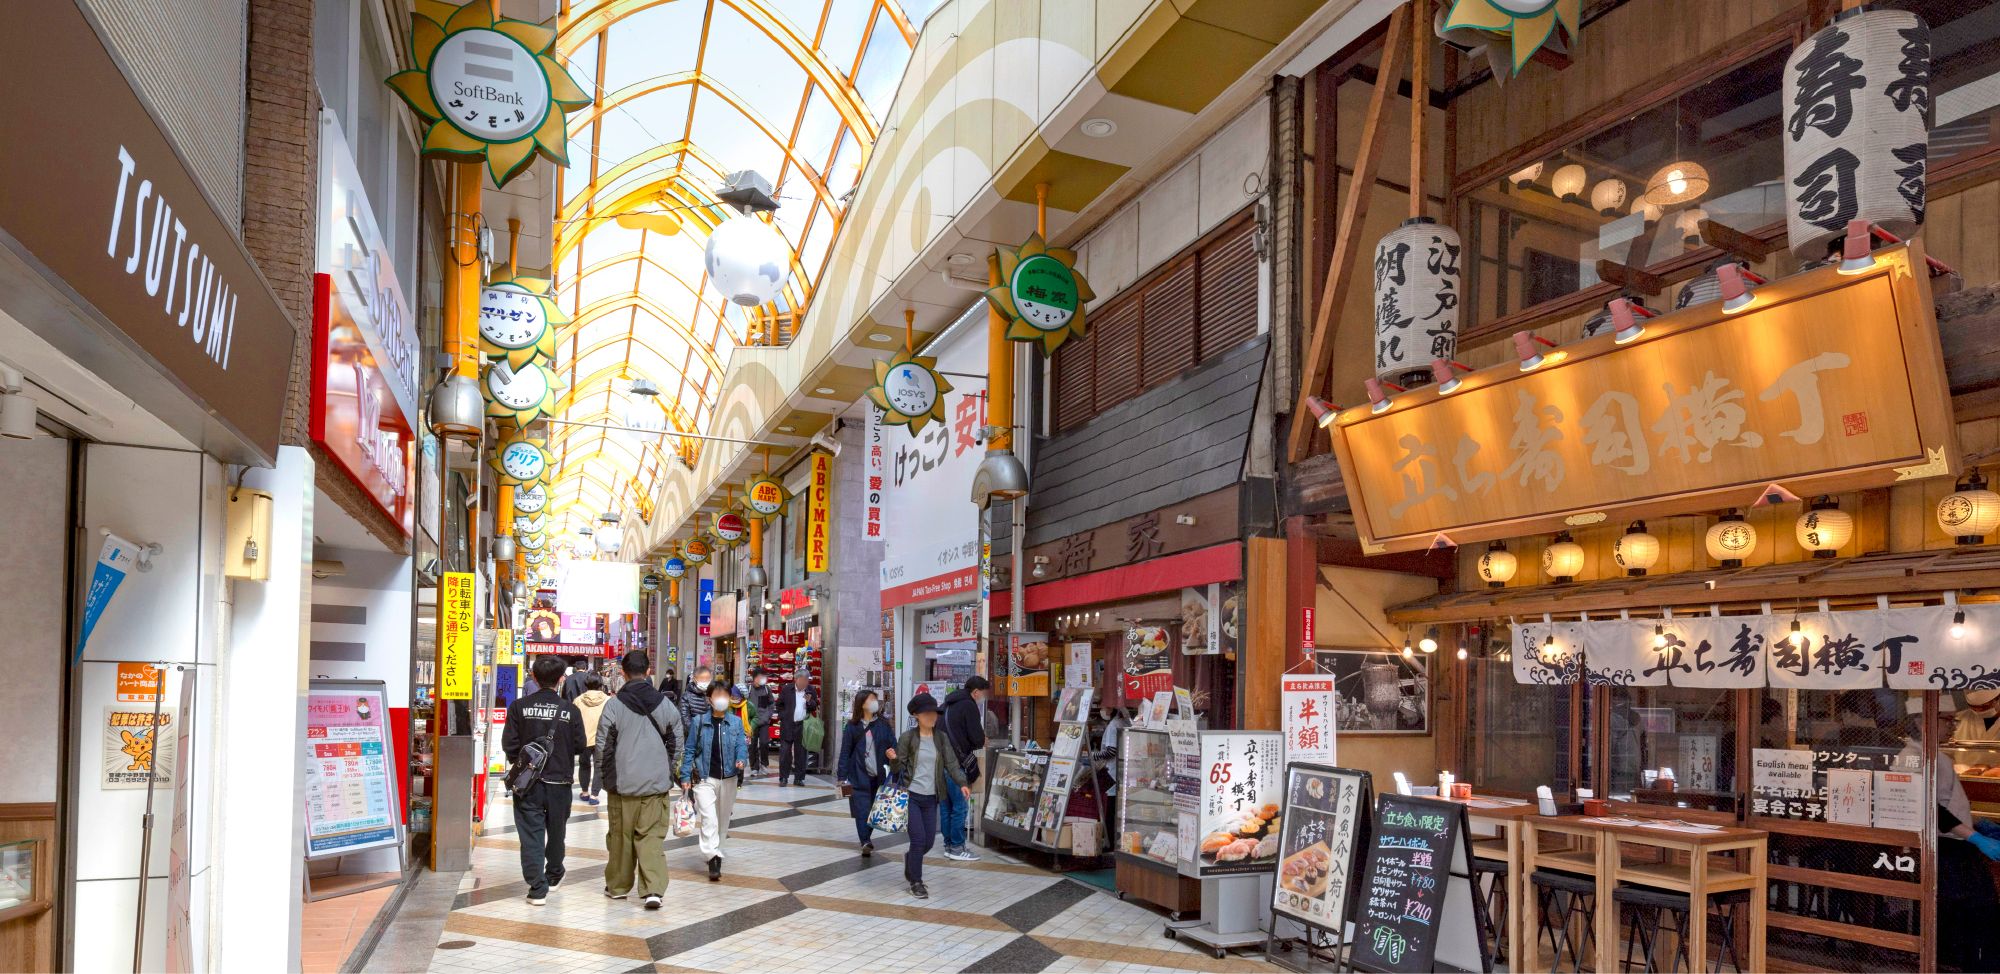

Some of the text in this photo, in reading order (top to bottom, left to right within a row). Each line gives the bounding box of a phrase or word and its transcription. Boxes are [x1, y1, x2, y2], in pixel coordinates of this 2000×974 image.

[454, 81, 524, 106] SoftBank
[1788, 26, 1866, 231] 寿司
[108, 144, 237, 370] TSUTSUMI
[1421, 236, 1461, 362] 江戸前
[482, 306, 536, 323] マルゼン
[368, 250, 415, 402] SoftBank
[1390, 351, 1851, 519] 立ち寿司横丁
[507, 451, 539, 466] アリア
[758, 486, 777, 495] ABC
[758, 494, 776, 502] MART
[867, 476, 882, 537] 愛の買取
[1805, 513, 1820, 546] 寿司
[1058, 513, 1163, 577] 梅家
[938, 547, 959, 567] イオシス
[912, 588, 924, 597] JAPAN
[925, 583, 940, 595] Tax-Free
[941, 581, 951, 591] Shop
[460, 577, 471, 632] 自転車から
[446, 576, 458, 687] 降りてご通行ください
[770, 635, 799, 644] SALE
[525, 645, 605, 655] AKANO BROADWAY
[1643, 622, 1919, 676] 立ち寿司横丁
[110, 713, 171, 727] 犯罪は許さい
[1298, 697, 1320, 750] 半額
[1244, 740, 1258, 803] 立ち寿司
[1757, 760, 1809, 770] English menu
[1905, 755, 1920, 768] 席
[1210, 763, 1232, 784] 65
[1768, 770, 1801, 779] available
[1232, 782, 1245, 811] 横丁
[1753, 798, 1828, 819] 宴会ご予
[1316, 820, 1326, 839] 冬の
[1383, 811, 1445, 831] 立ち食い限定
[1300, 825, 1308, 848] 盛り
[1379, 835, 1429, 849] サワーハイボール
[1377, 856, 1406, 868] ハイボール
[1412, 852, 1433, 867] 半額
[1873, 852, 1914, 872] 入口
[1376, 865, 1407, 878] レモンサワー
[1369, 898, 1397, 910] 緑茶ハイ
[1404, 898, 1432, 921] ¥240
[1368, 908, 1401, 924] ウーロンハイ
